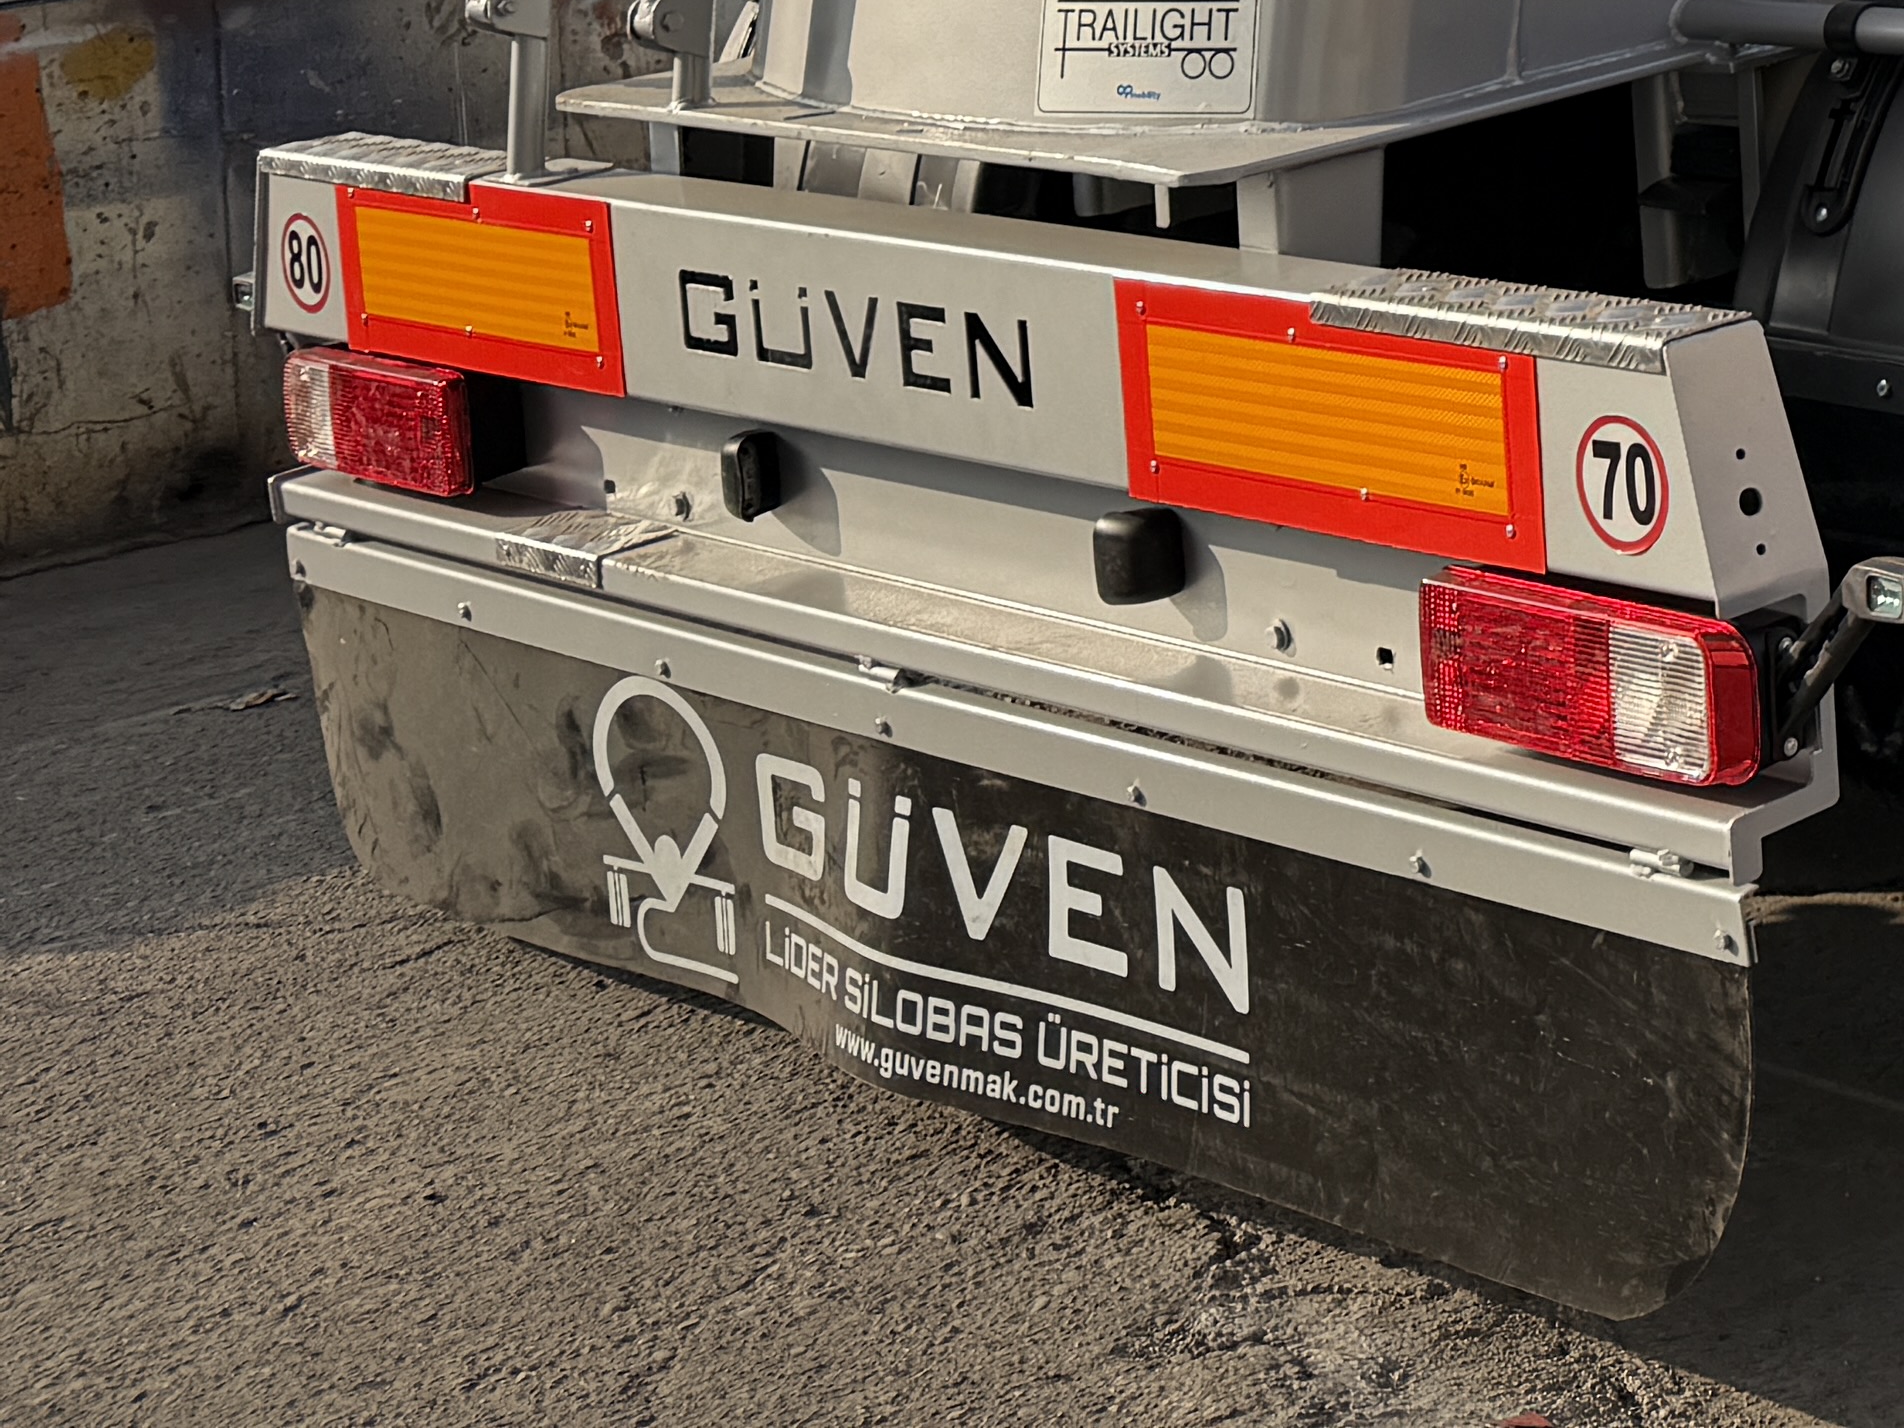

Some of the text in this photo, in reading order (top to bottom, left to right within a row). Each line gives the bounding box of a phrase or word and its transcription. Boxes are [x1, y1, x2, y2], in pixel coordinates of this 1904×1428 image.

[1056, 7, 1240, 52] TRAILIGHT
[1108, 42, 1171, 58] SYSTEMS
[287, 229, 325, 295] 80
[678, 268, 1035, 409] GÜVEN
[1591, 440, 1656, 526] 70
[754, 752, 1251, 1015] GÜVEN
[835, 1022, 1120, 1129] www.guvenmak.com.tr
